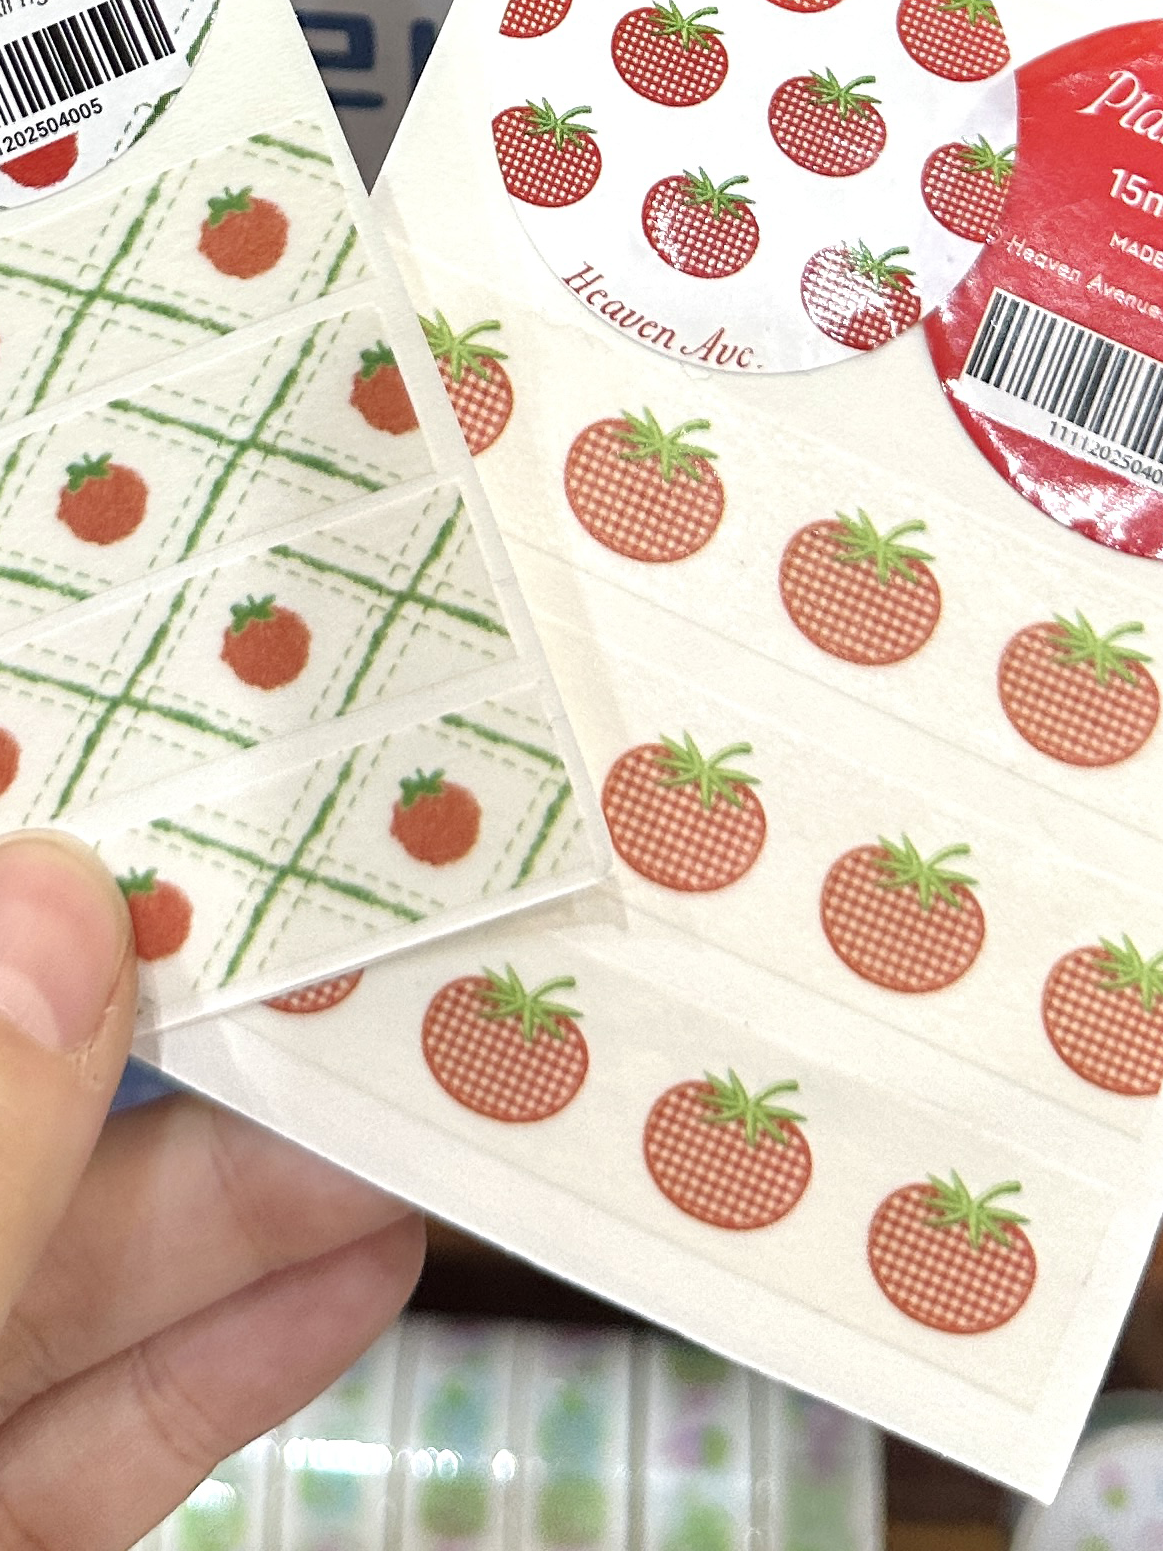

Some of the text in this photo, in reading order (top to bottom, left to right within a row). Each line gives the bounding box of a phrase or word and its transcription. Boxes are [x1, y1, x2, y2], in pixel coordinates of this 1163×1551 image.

[1076, 70, 1163, 145] Pla
[1004, 234, 1082, 283] Heaven
[1109, 231, 1163, 270] MADE
[561, 260, 677, 349] Heaven
[1049, 420, 1163, 485] 11112025040
